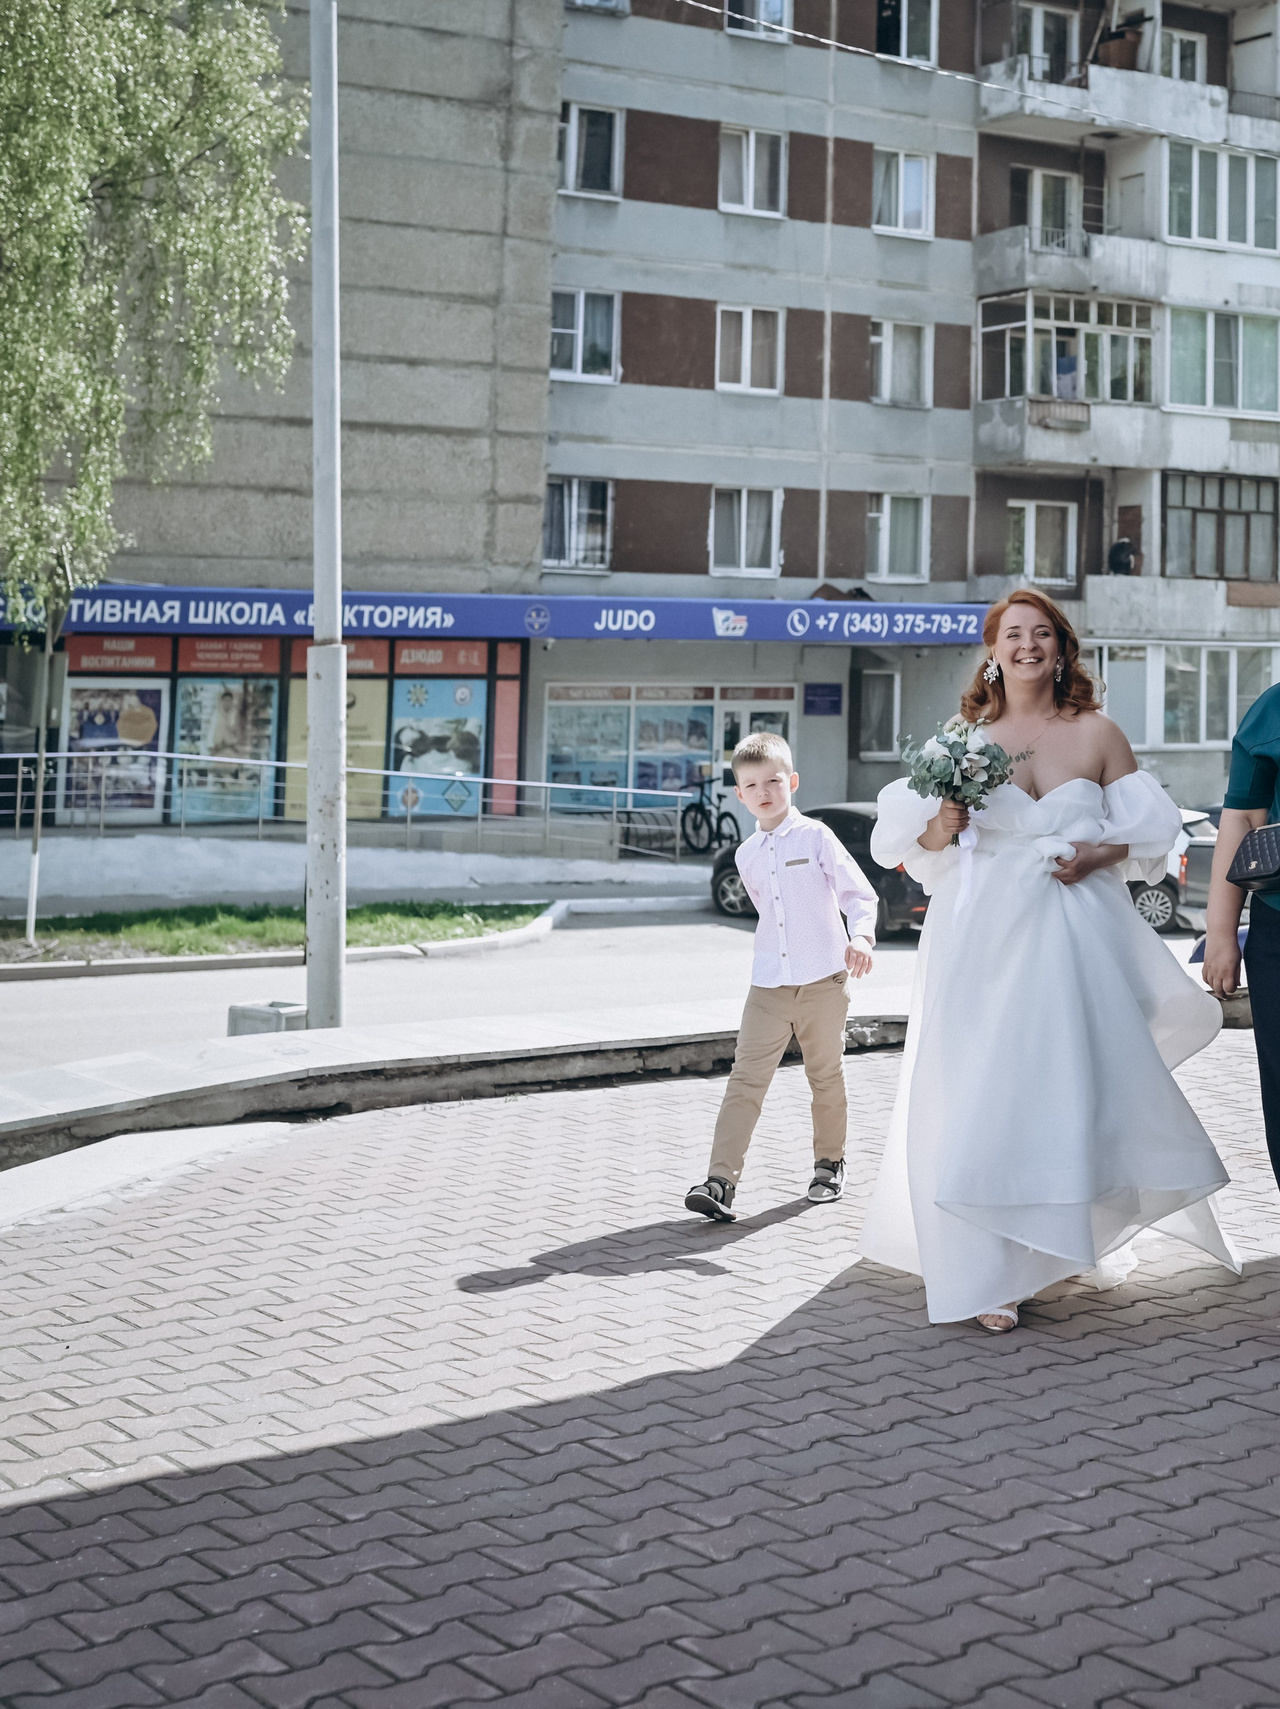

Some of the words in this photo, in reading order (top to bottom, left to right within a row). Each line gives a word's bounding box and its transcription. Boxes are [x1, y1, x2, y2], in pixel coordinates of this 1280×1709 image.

[188, 600, 287, 626] ШКОЛА
[293, 603, 455, 629] «КТОРИЯ»
[594, 608, 656, 632] JUDO
[815, 612, 840, 633] +7
[843, 612, 889, 638] (343)
[893, 613, 979, 635] 375-79-72
[400, 649, 443, 666] ДЗЮДО
